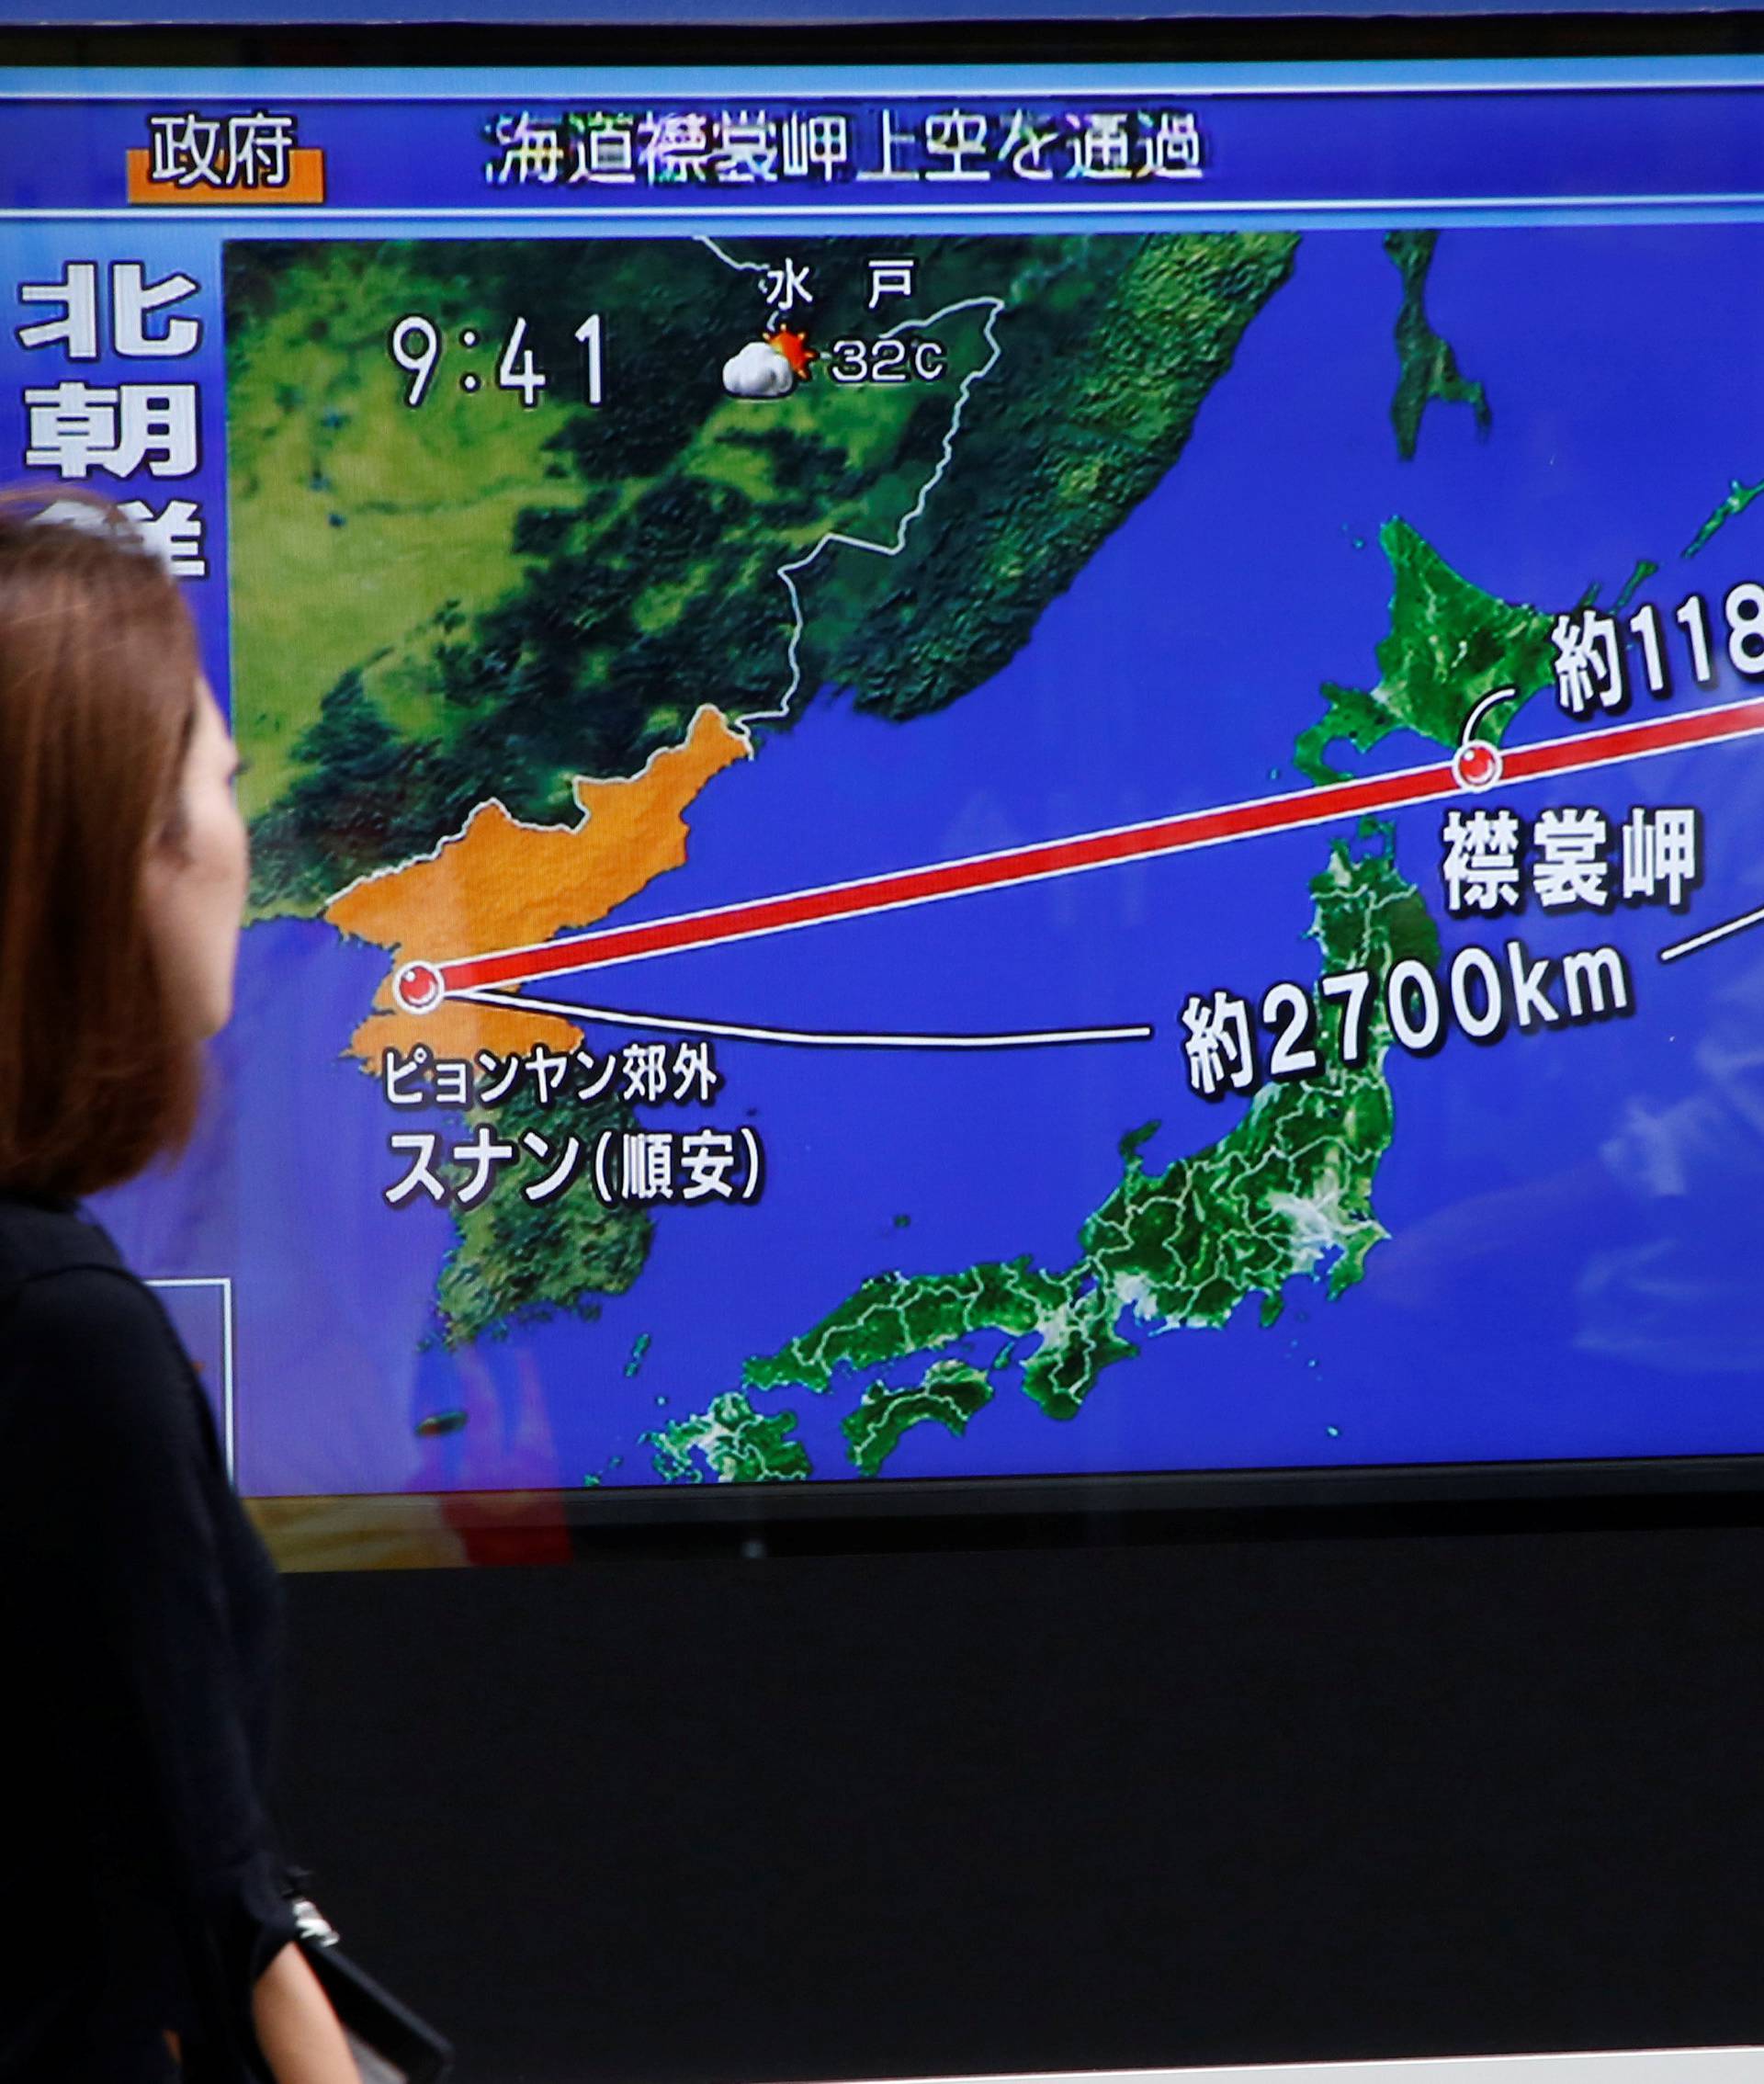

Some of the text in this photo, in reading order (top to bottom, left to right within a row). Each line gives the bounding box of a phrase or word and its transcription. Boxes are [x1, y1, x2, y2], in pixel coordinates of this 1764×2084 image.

[151, 111, 292, 185] 政府
[392, 314, 603, 406] 9:41
[1551, 583, 1764, 713] 約118
[1442, 808, 1696, 911] 襟裳岬
[1181, 941, 1627, 1094] 約2700km
[386, 1041, 718, 1104] ピョンヤン郊外
[385, 1127, 760, 1203] スナン(順安)
